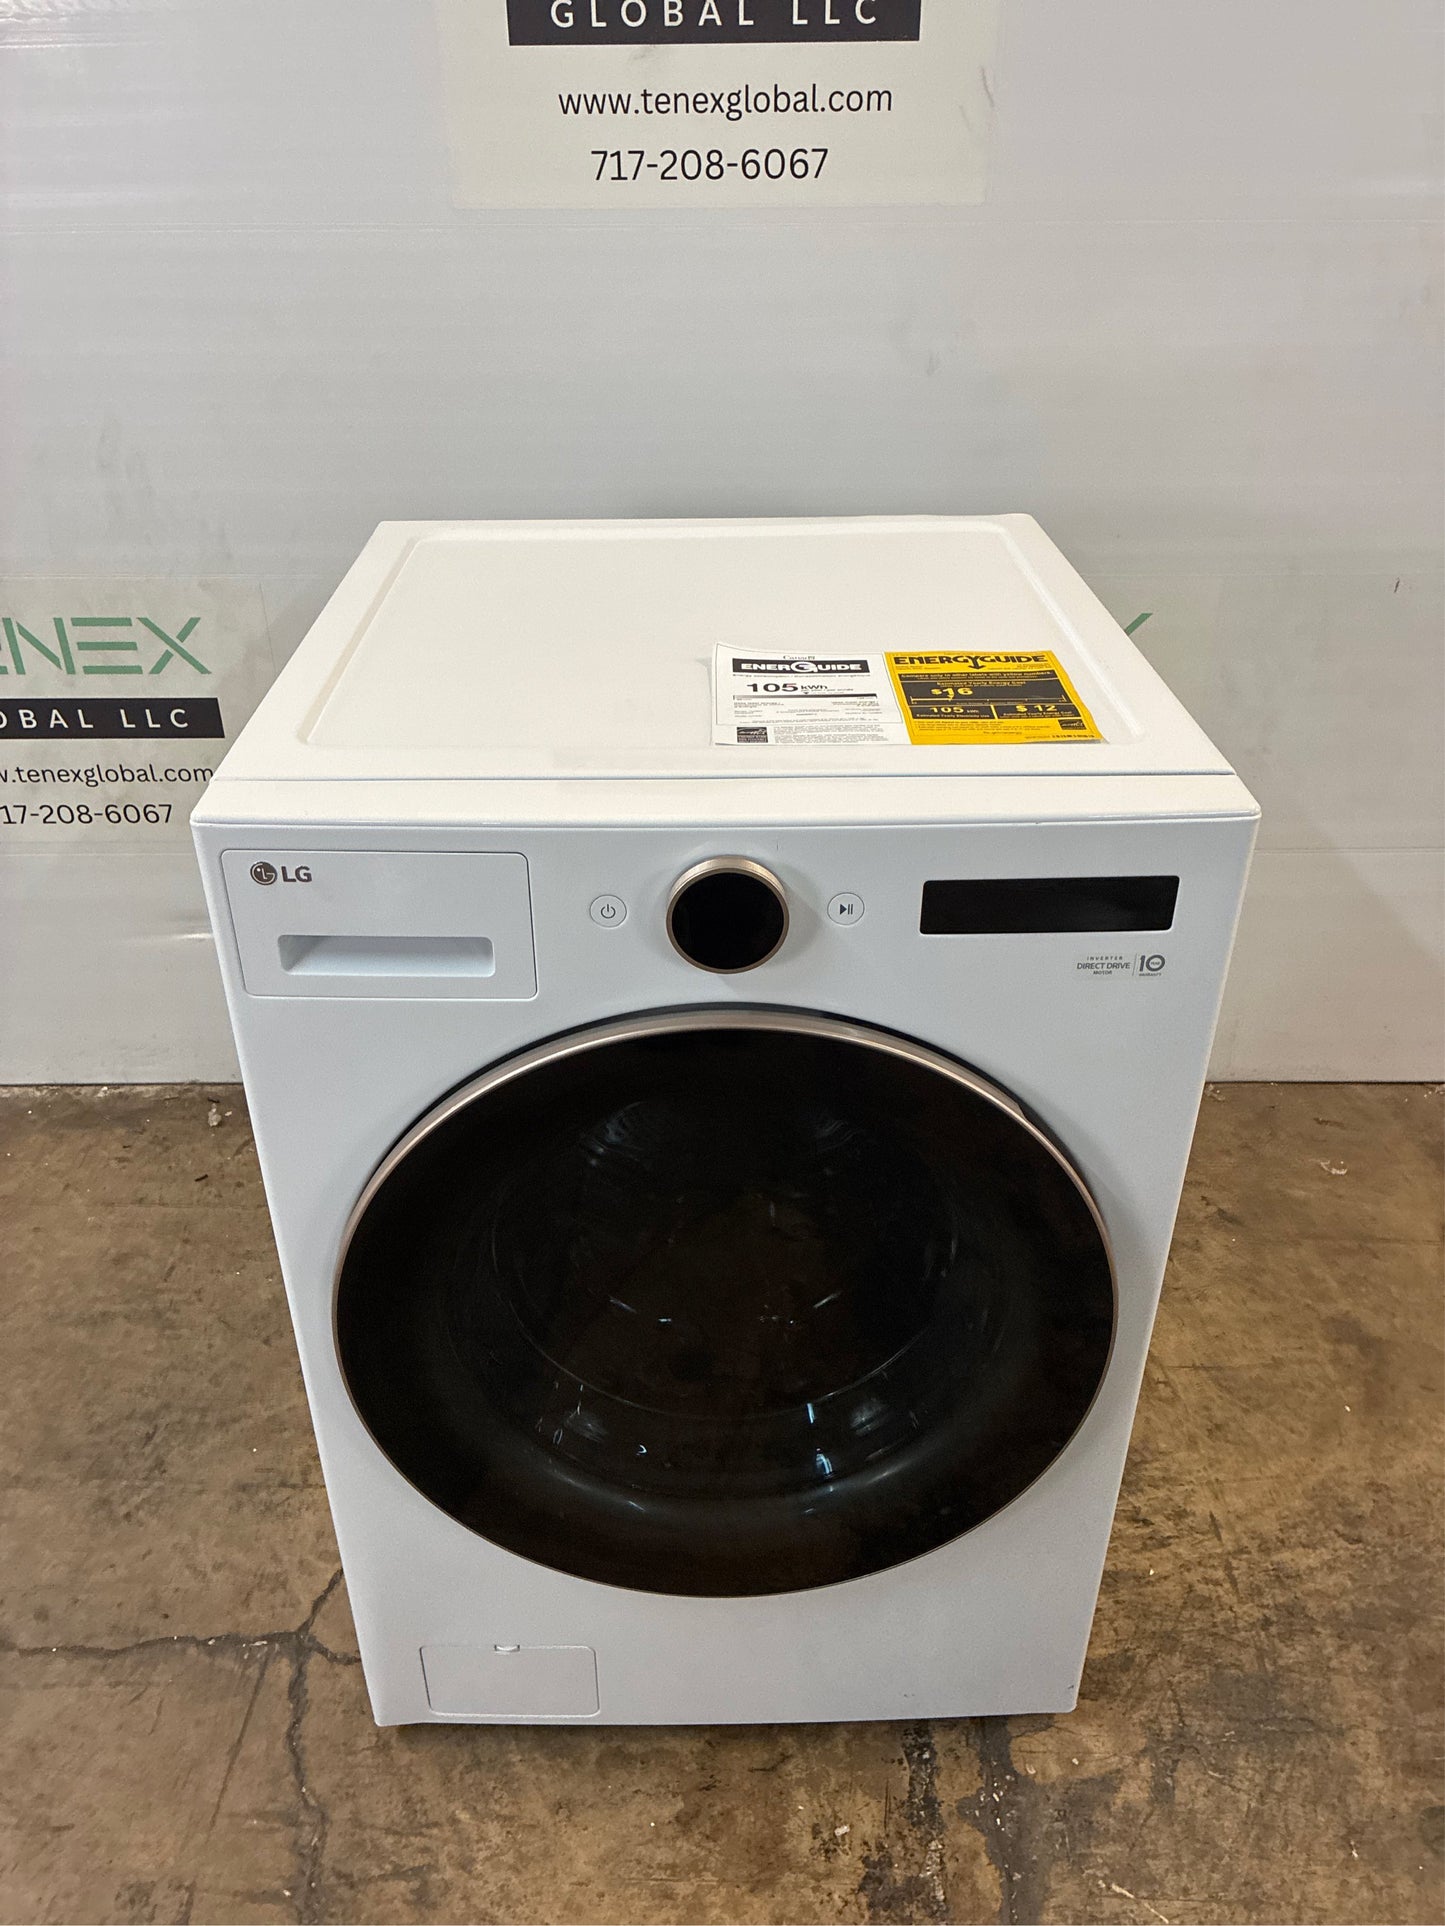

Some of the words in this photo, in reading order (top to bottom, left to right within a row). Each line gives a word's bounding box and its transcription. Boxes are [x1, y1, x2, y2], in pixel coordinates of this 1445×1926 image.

[549, 0, 755, 29] GLOBAL
[791, 0, 877, 25] LLC
[558, 83, 893, 121] www.tenexglobal.com
[590, 147, 830, 182] 717-208-6067
[741, 661, 862, 673] ENERGUIDE
[893, 654, 1049, 667] ENERGYGUIDE
[747, 682, 799, 692] 105
[119, 708, 189, 729] LLC
[281, 865, 313, 883] LG
[1076, 962, 1105, 970] DIRECT
[1106, 961, 1131, 969] DRIVE
